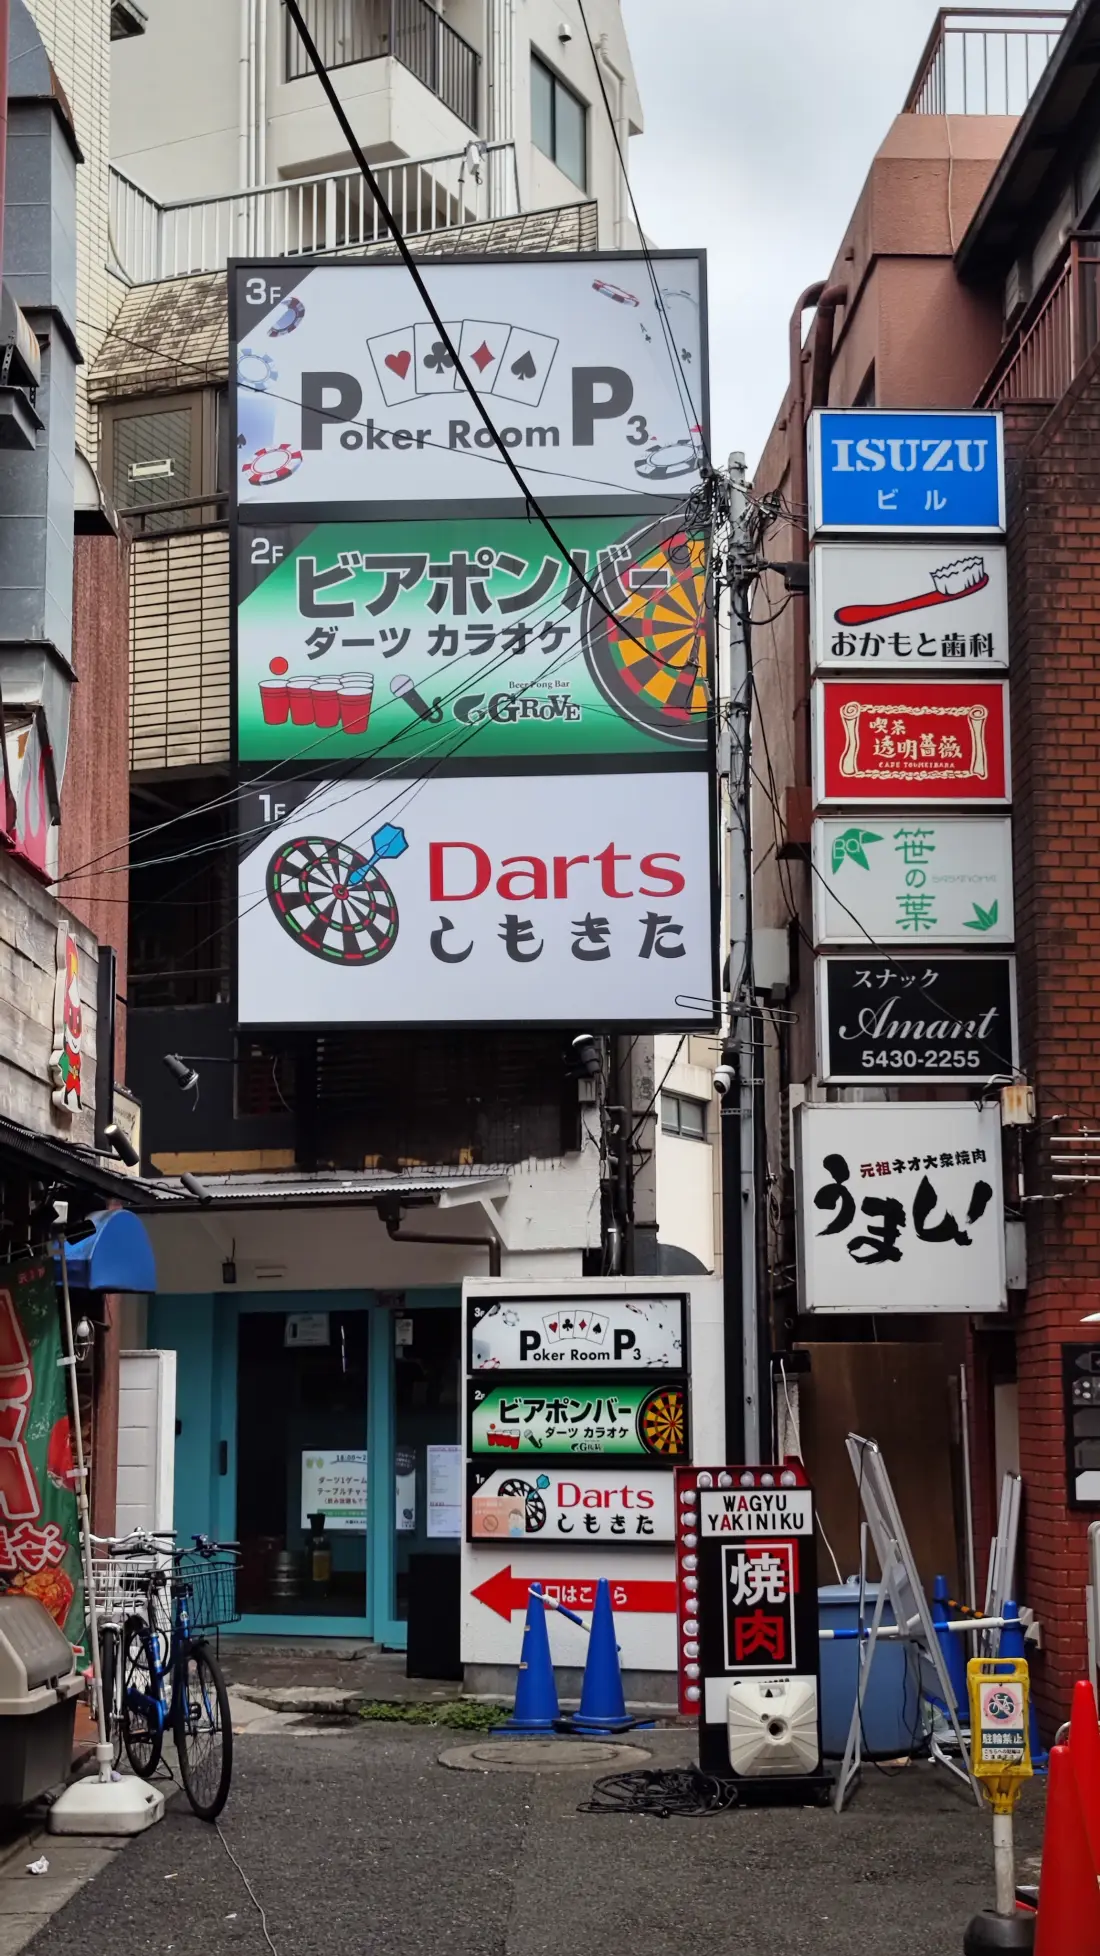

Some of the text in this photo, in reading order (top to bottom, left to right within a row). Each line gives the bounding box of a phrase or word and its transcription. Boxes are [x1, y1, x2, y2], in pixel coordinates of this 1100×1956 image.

[245, 278, 281, 306] 3F
[301, 366, 649, 451] Poker Room P3
[831, 438, 989, 472] ISUZU
[877, 488, 948, 511] ビル
[250, 537, 284, 565] 2F
[296, 545, 671, 618] ビアポンバー
[305, 622, 572, 661] ダーツ カラオケ
[831, 632, 995, 658] おかもと歯科
[869, 717, 906, 735] 喫茶
[873, 733, 963, 760] 透明薔薇
[258, 794, 286, 822] 1F
[833, 831, 868, 860] Bar
[429, 841, 686, 902] Darts
[893, 828, 937, 932] 笹の葉
[429, 911, 687, 964] しもきた
[852, 968, 939, 989] スナック
[838, 996, 999, 1041] Amant
[861, 1050, 980, 1068] 5430-2255
[860, 1148, 988, 1179] 元祖ネオ大衆焼肉
[474, 1307, 486, 1317] 3F
[519, 1330, 565, 1361] Poker
[570, 1349, 610, 1361] Room
[499, 1396, 632, 1425] ビアポンバー
[545, 1427, 629, 1439] ダーツ カラオケ
[557, 1483, 655, 1509] Darts
[723, 1495, 788, 1512] WAGYU
[557, 1513, 655, 1534] しもきた
[708, 1512, 805, 1532] YAKINIKU
[545, 1585, 627, 1605] 口はこら
[729, 1552, 787, 1661] 焼肉
[982, 1733, 1024, 1745] 駐輪禁止
